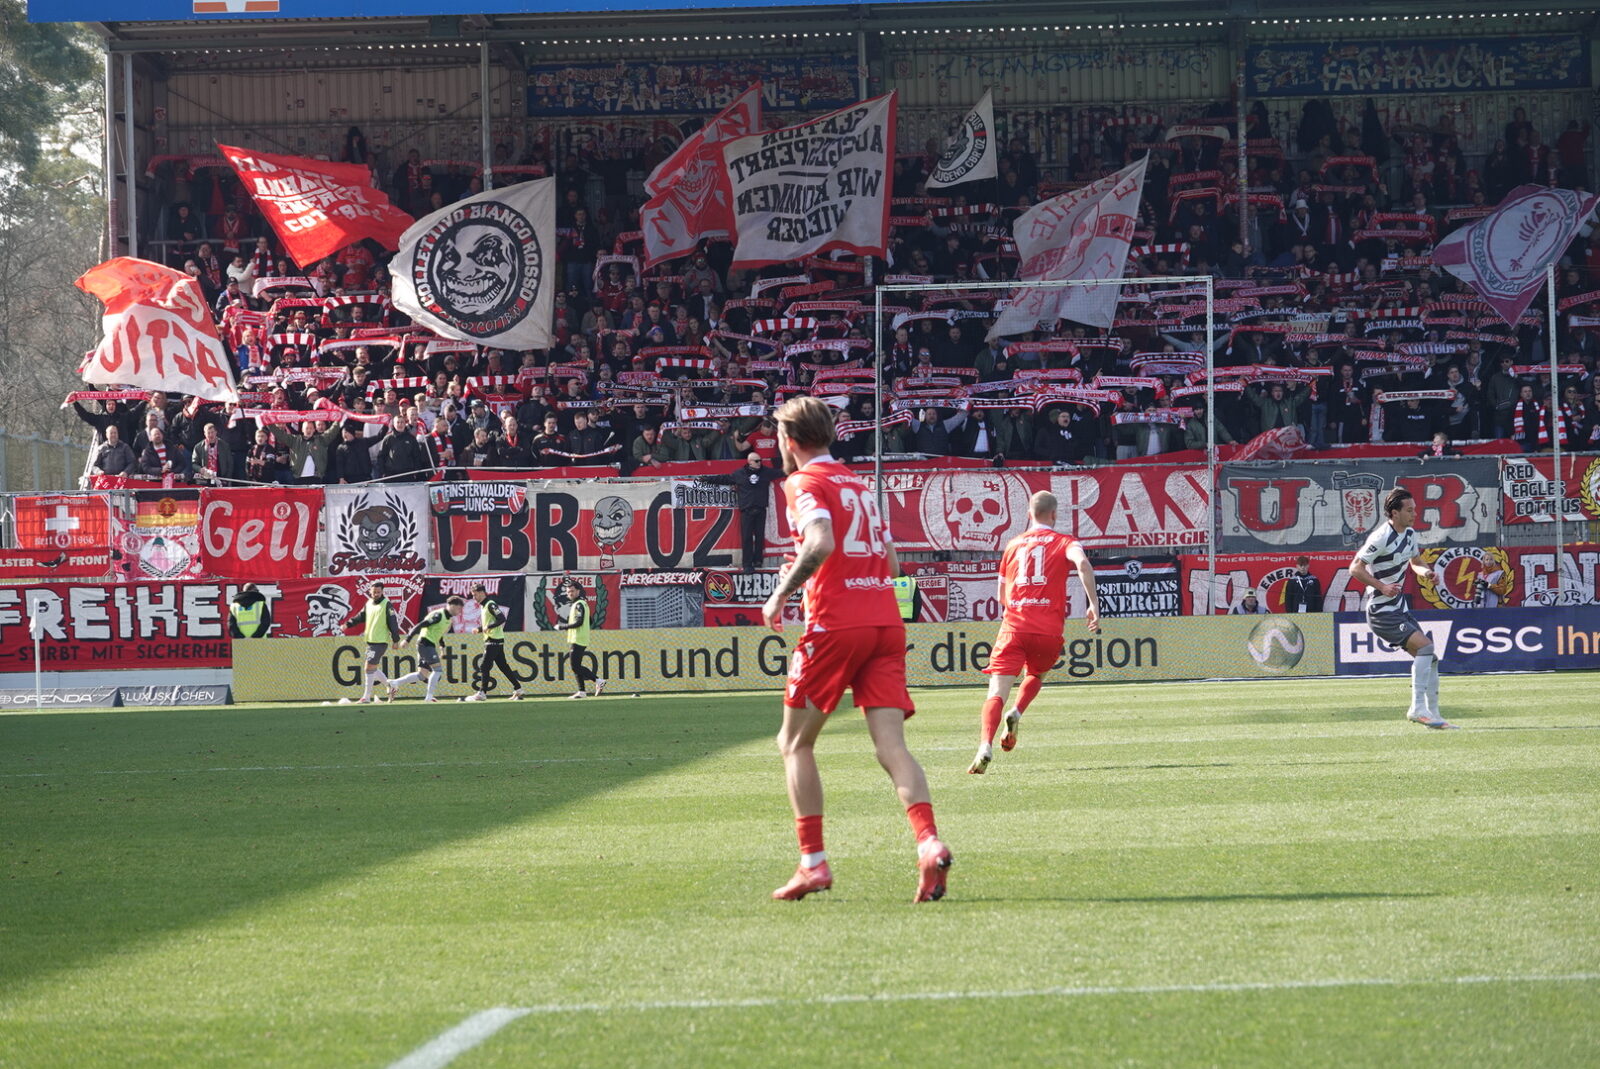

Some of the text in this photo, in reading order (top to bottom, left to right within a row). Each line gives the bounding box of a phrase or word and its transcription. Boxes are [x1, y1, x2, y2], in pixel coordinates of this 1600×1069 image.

[469, 204, 533, 240] BIANCO
[522, 239, 541, 302] ROSSO
[1506, 464, 1534, 480] RED
[444, 484, 515, 499] FINSTERWALDER
[1512, 481, 1566, 499] EAGLES
[462, 498, 496, 512] JUNGS
[1516, 499, 1581, 517] COTTBUS
[202, 499, 310, 562] Geil
[1127, 530, 1209, 547] ENERGIE
[69, 555, 109, 566] FRONT
[947, 562, 997, 573] SACHE DIE
[1015, 545, 1047, 587] 11
[620, 571, 704, 586] ENERGIEBEZIRK
[732, 573, 780, 595] VERBO
[915, 579, 943, 588] NERGIE
[1455, 626, 1544, 655] SSC
[92, 645, 124, 660] MIT
[660, 636, 740, 679] und
[930, 631, 993, 671] die
[1052, 632, 1159, 678] egion
